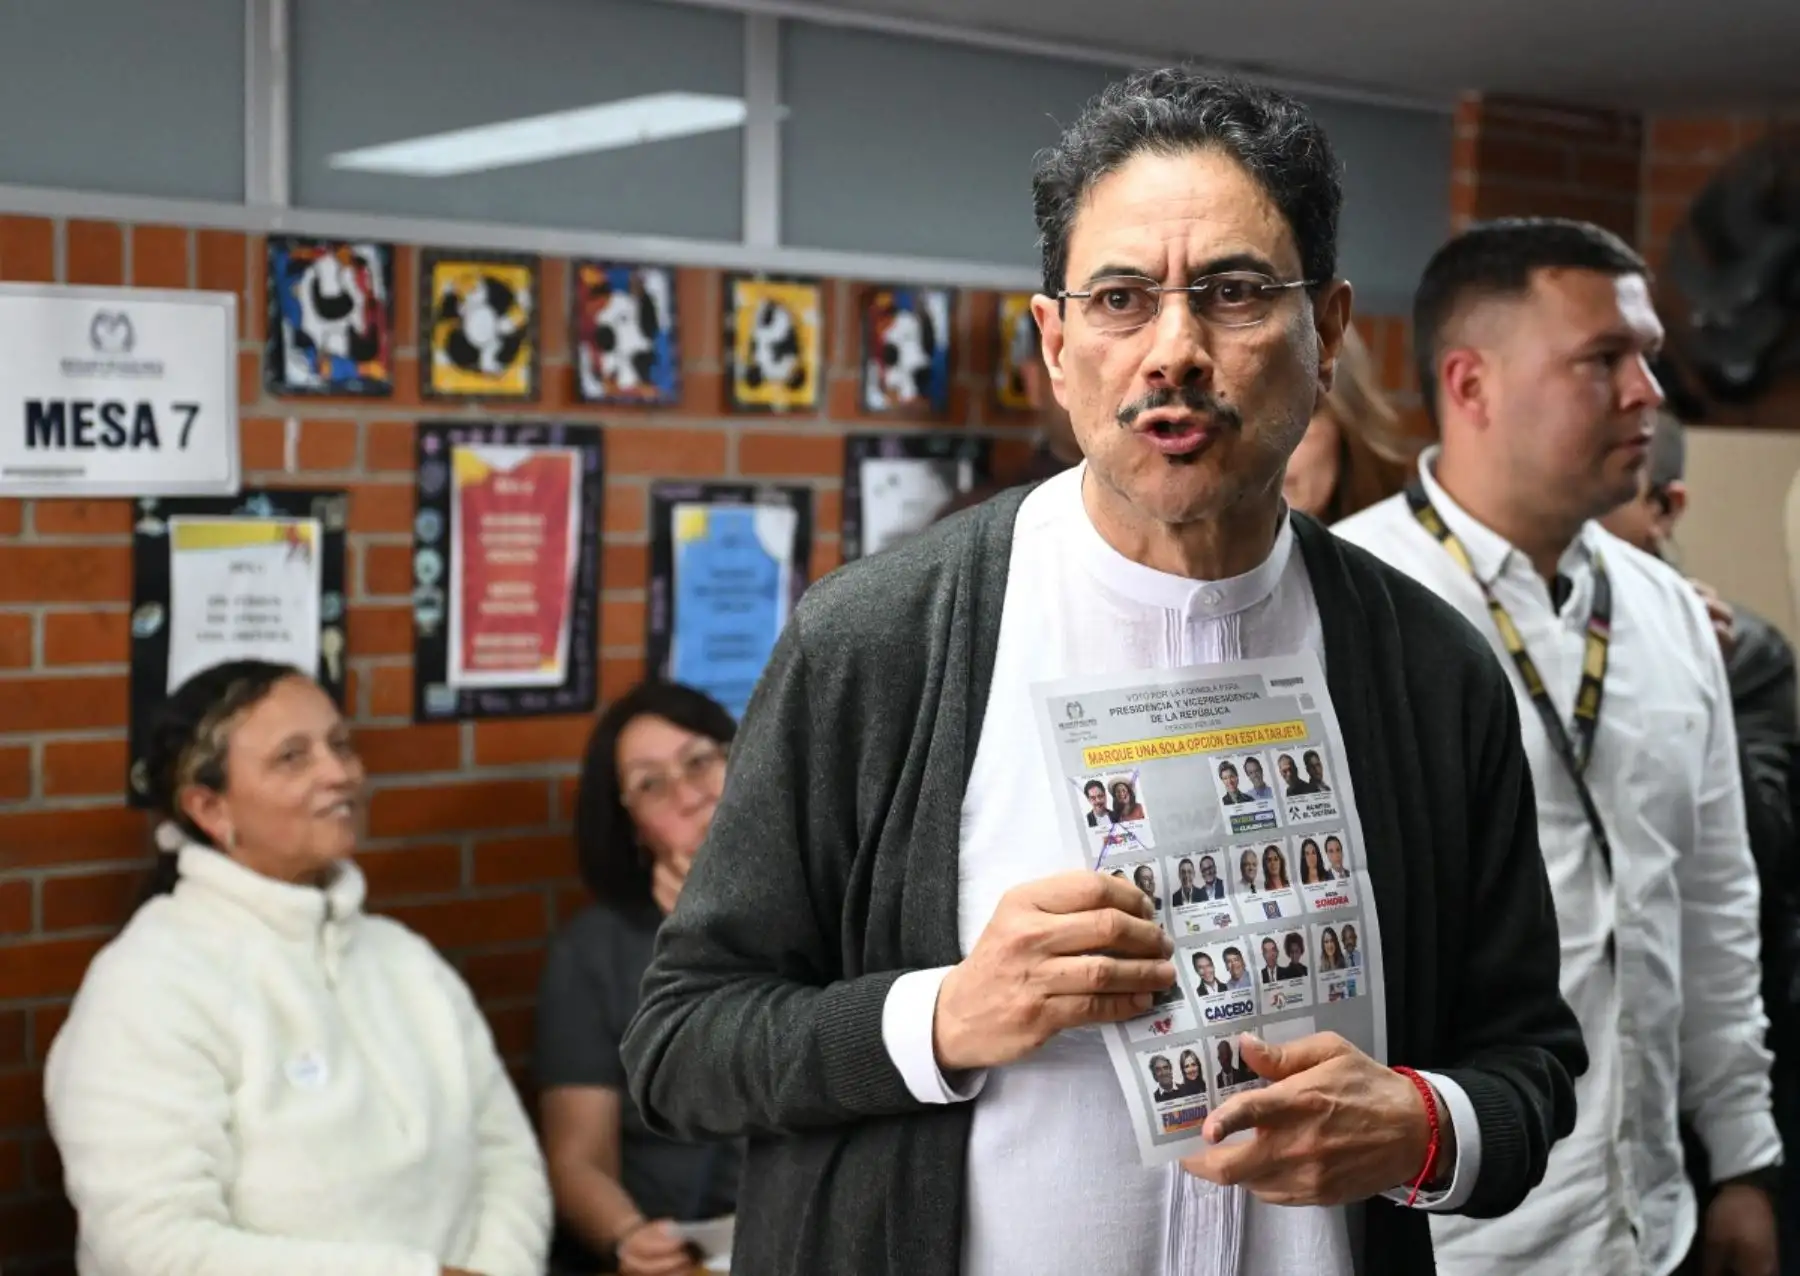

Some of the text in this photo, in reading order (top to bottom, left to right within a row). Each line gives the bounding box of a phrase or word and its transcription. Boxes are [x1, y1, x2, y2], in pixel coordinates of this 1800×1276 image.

[25, 400, 200, 450] MESA 7
[1109, 691, 1261, 717] PRESIDENCIA Y VICEPRESIDENCIA
[1151, 689, 1169, 700] POR
[1150, 713, 1164, 724] DE
[1164, 711, 1179, 722] LA
[1088, 747, 1134, 766] MARQUE
[1135, 744, 1159, 758] UNA
[1159, 740, 1186, 755] SOLA
[1224, 731, 1239, 746] EN
[1239, 728, 1265, 745] ESTA
[1264, 724, 1305, 741] TARJETA
[1205, 1000, 1254, 1020] CAICEDO
